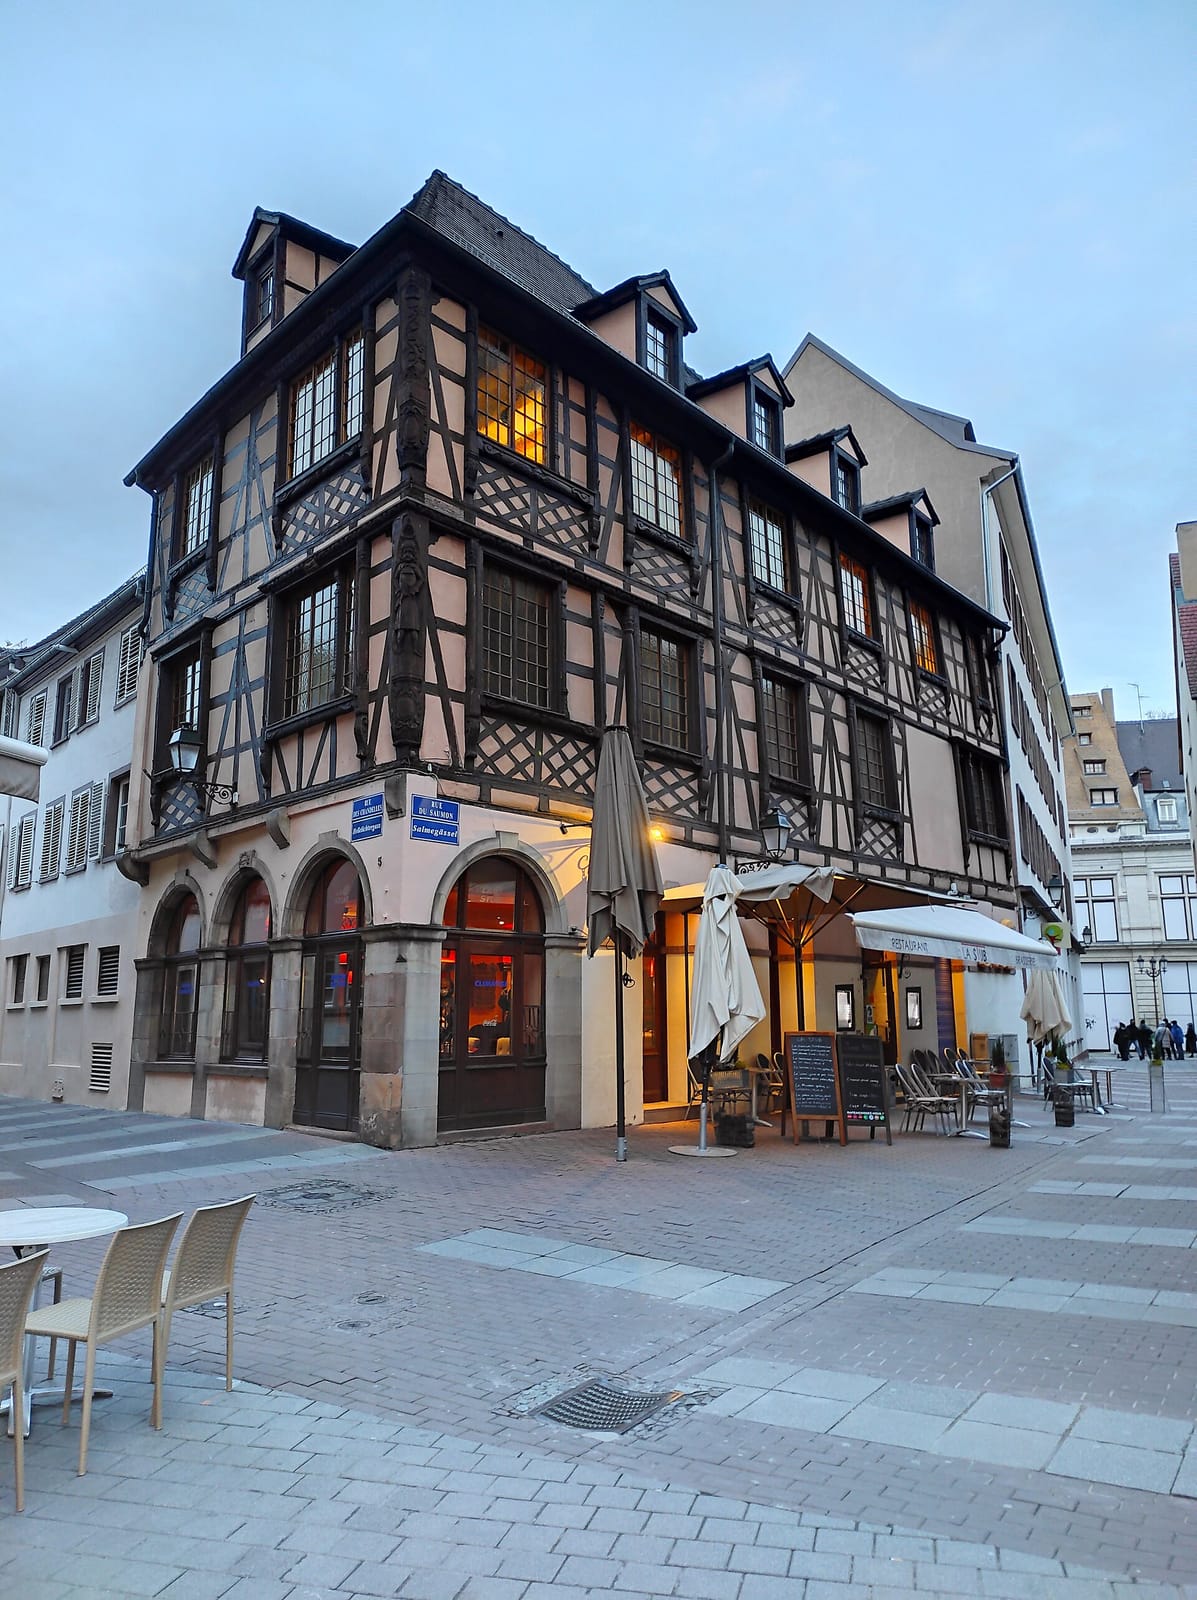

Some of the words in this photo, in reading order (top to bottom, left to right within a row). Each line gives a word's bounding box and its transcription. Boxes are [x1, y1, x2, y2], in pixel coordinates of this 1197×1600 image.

[431, 801, 443, 810] RUE
[418, 807, 427, 815] DU
[429, 809, 454, 820] SAUMON
[412, 824, 458, 837] Salmegässel
[891, 937, 929, 952] RESTAURANT
[962, 947, 972, 960] LA
